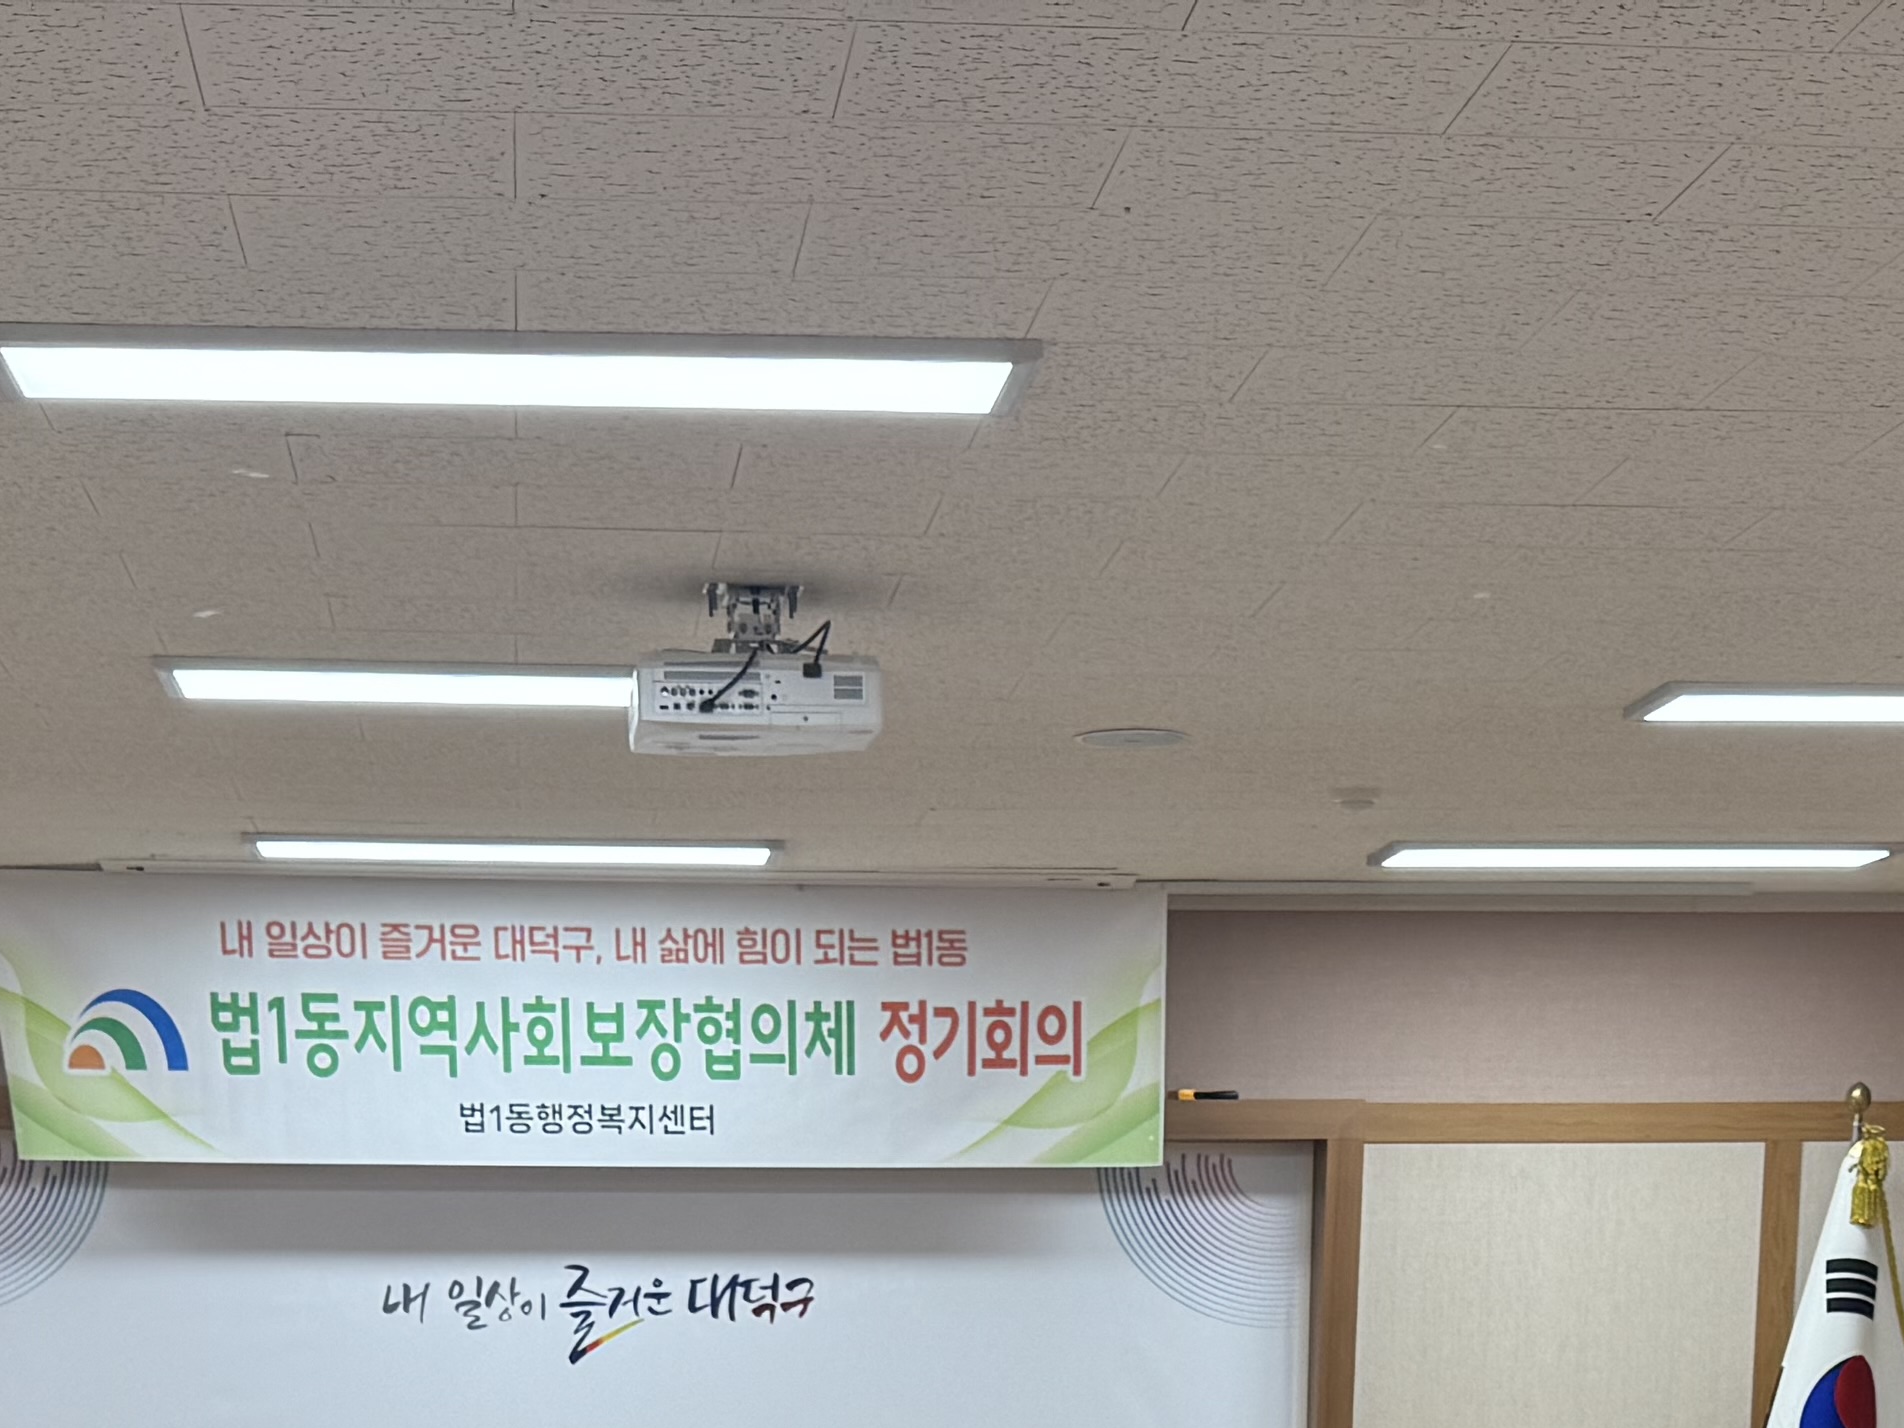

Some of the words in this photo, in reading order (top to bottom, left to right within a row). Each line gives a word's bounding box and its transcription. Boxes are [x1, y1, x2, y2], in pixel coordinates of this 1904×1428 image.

[219, 919, 253, 958] 내
[265, 920, 369, 960] 일상이
[378, 921, 482, 962] 즐거운
[494, 923, 602, 966] 대덕구,
[614, 926, 648, 964] 내
[657, 926, 725, 966] 삶에
[736, 926, 802, 967] 힘이
[814, 927, 880, 967] 되는
[891, 928, 968, 969] 법1동
[209, 990, 856, 1083] 법1동지역사회보장협의체
[878, 998, 1084, 1084] 정기회의
[459, 1101, 716, 1137] 법1동행정복지센터
[382, 1281, 431, 1320] 내
[447, 1274, 547, 1330] 일상이
[558, 1263, 673, 1365] 즐거운
[687, 1271, 816, 1325] 대덕구
